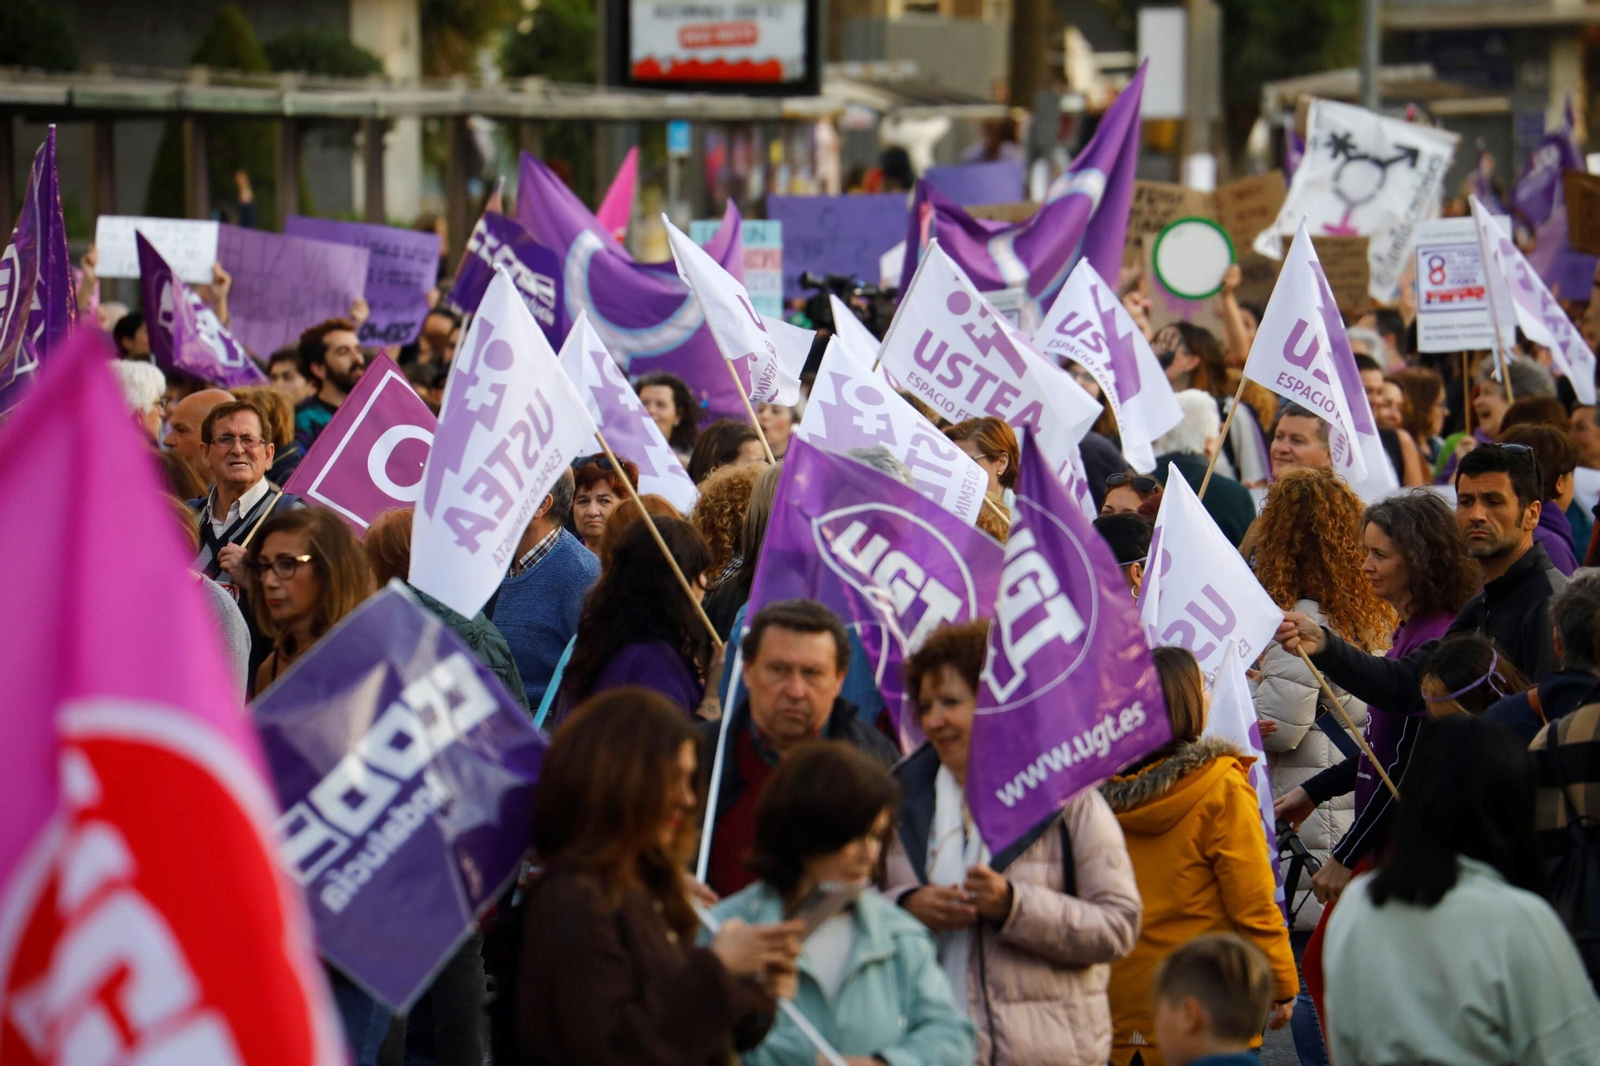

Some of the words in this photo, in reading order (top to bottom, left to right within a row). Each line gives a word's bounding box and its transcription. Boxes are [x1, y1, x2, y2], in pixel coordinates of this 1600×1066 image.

[913, 328, 1043, 434] USTEA
[1047, 338, 1094, 366] ESPACIO
[906, 371, 955, 413] ESPACIO
[1276, 371, 1335, 414] ESPACIO
[831, 520, 962, 656] UGT
[995, 700, 1146, 808] www.ugt.es
